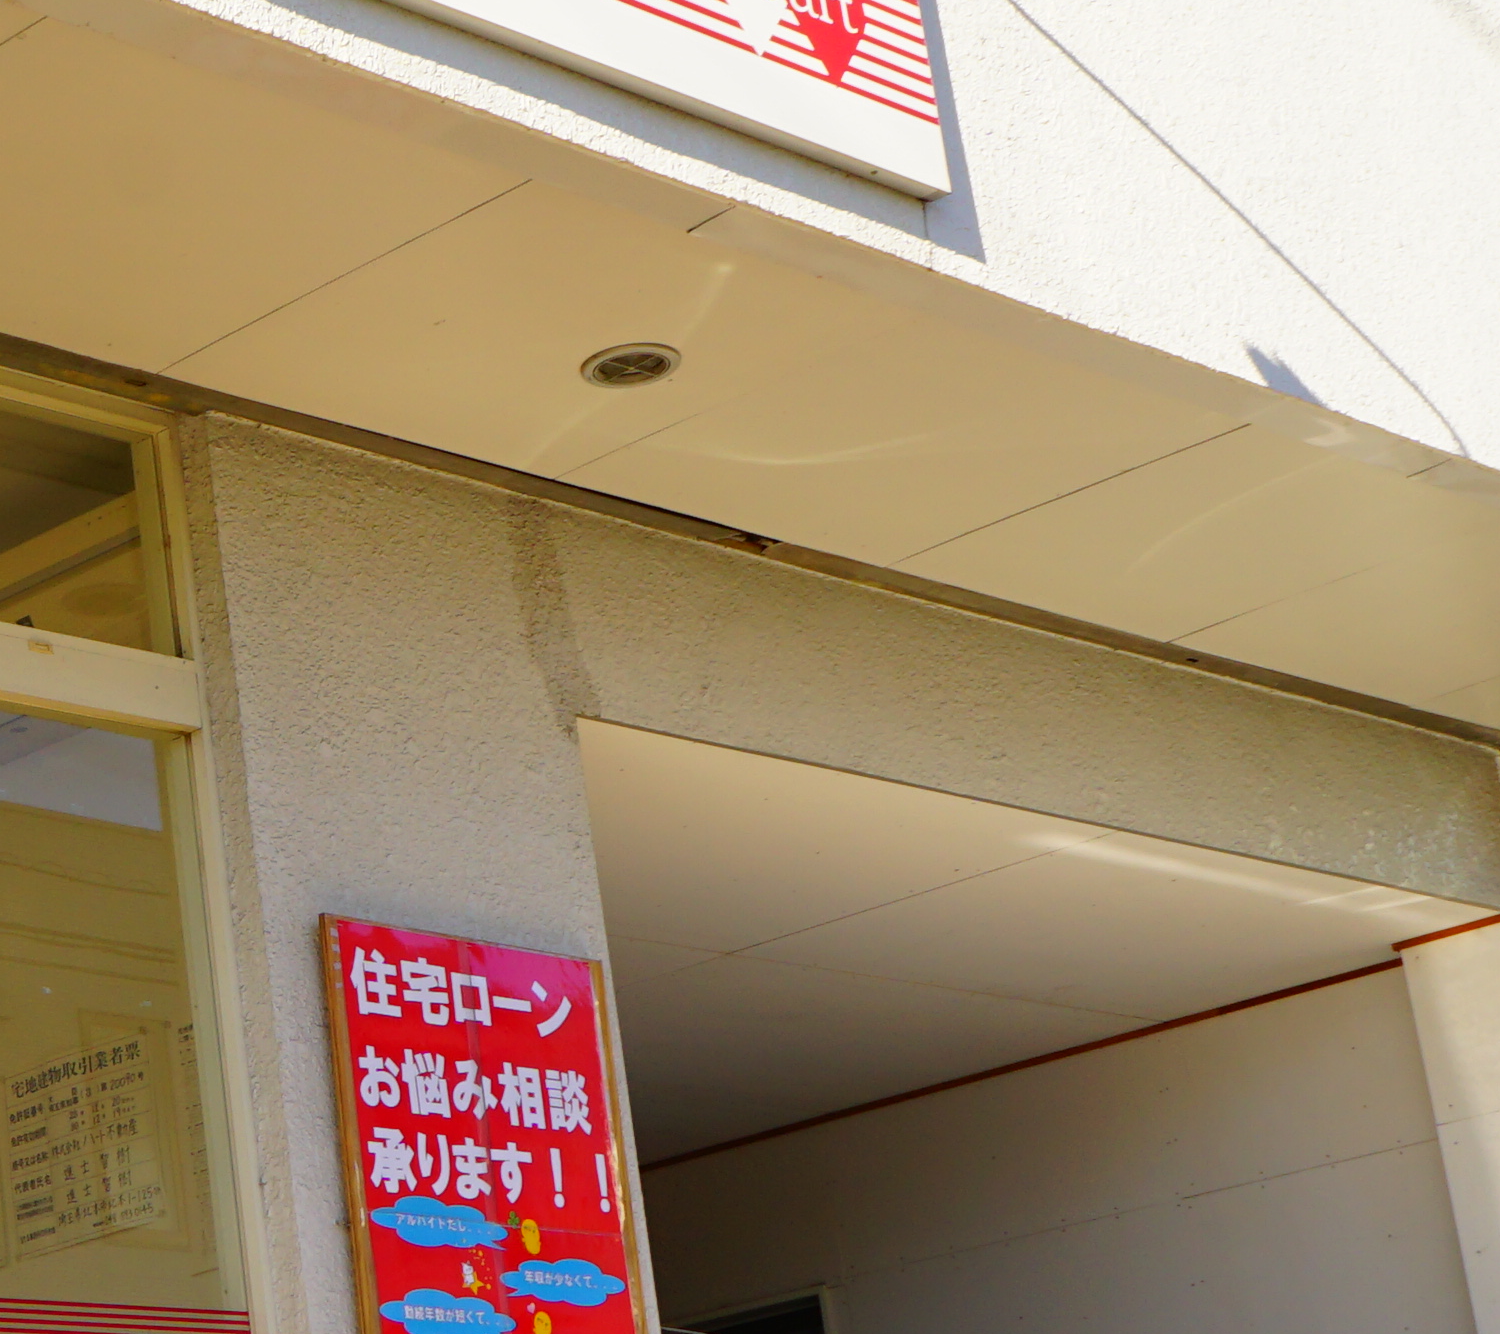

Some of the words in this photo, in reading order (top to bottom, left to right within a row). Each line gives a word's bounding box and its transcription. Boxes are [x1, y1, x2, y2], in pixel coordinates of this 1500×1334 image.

[350, 945, 571, 1038] 住宅ローン
[10, 1040, 141, 1099] 宅地建物取引業者票
[358, 1044, 592, 1135] お悩み相談
[367, 1127, 612, 1213] 承ります！！
